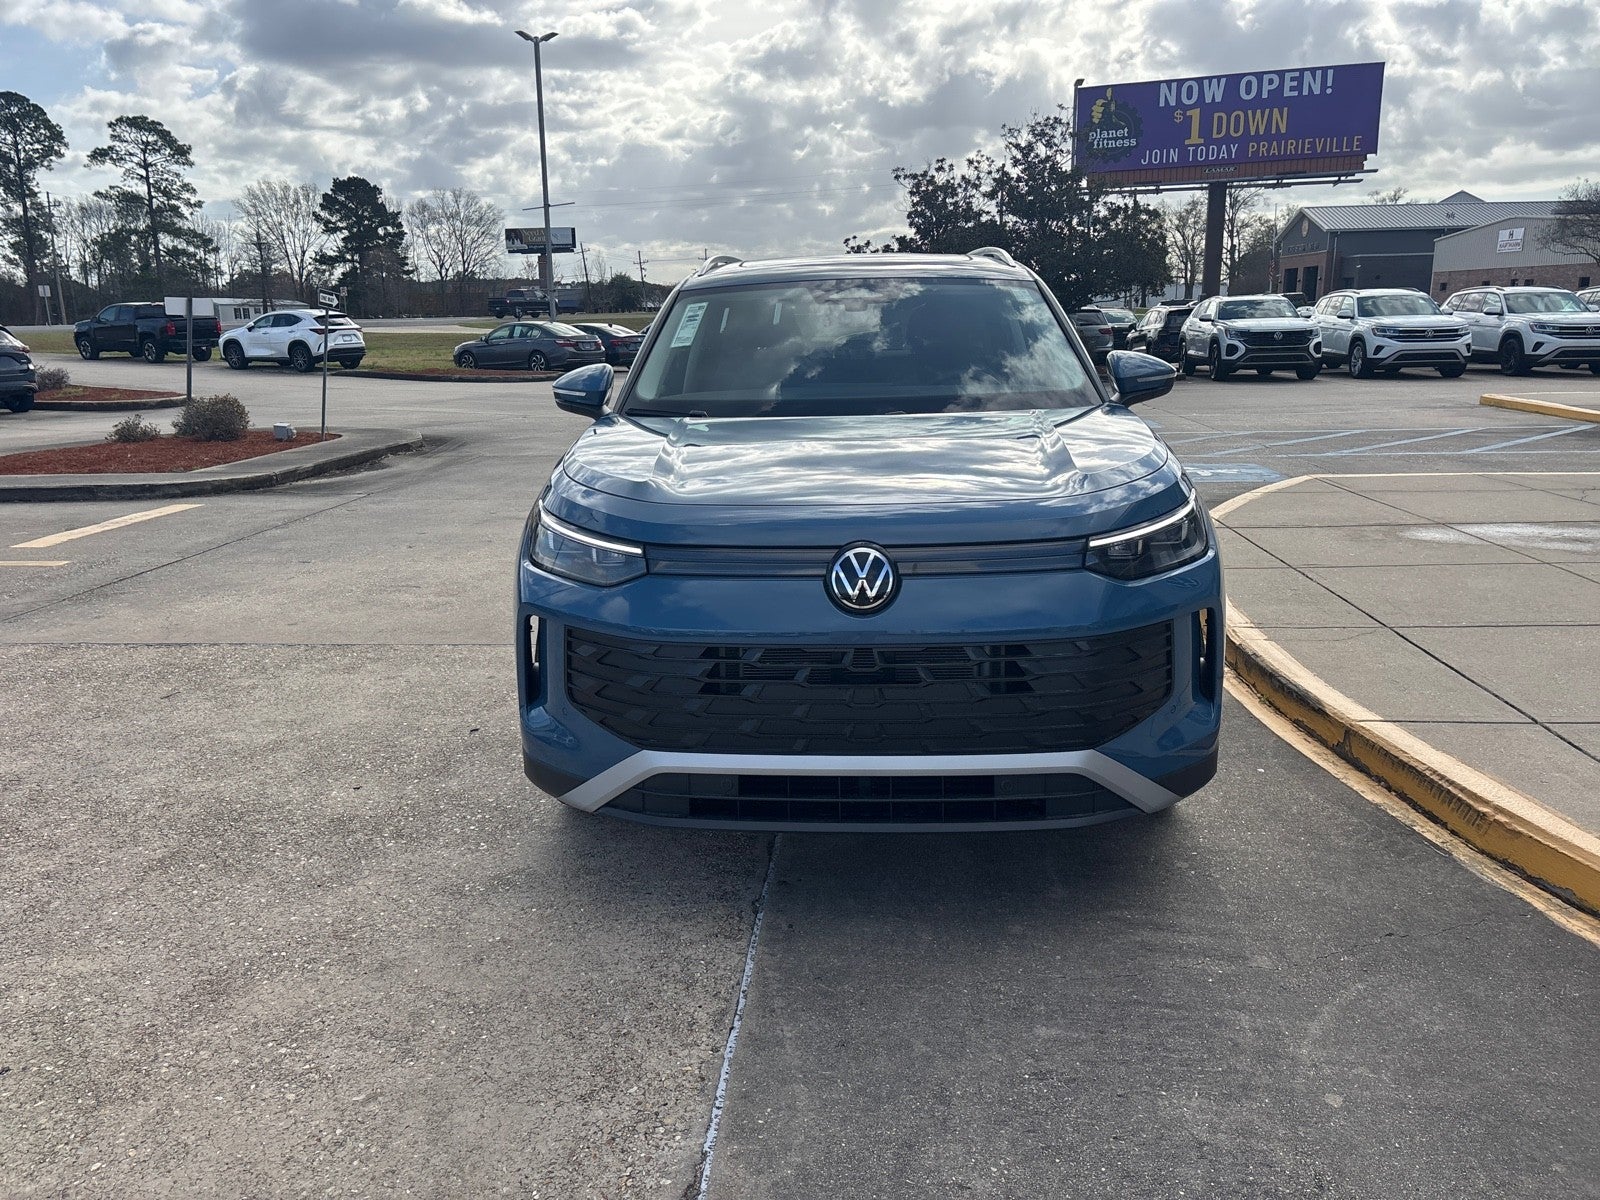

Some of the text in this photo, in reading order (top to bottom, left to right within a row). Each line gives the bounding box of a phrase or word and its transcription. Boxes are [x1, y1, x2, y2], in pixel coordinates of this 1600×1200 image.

[1159, 69, 1334, 107] NOW OPEN!
[1088, 127, 1129, 142] planet
[1174, 107, 1288, 145] $1 DOWN
[1093, 137, 1137, 149] fitness
[1141, 135, 1363, 165] JOIN TODAY PRAIRIEVILLE
